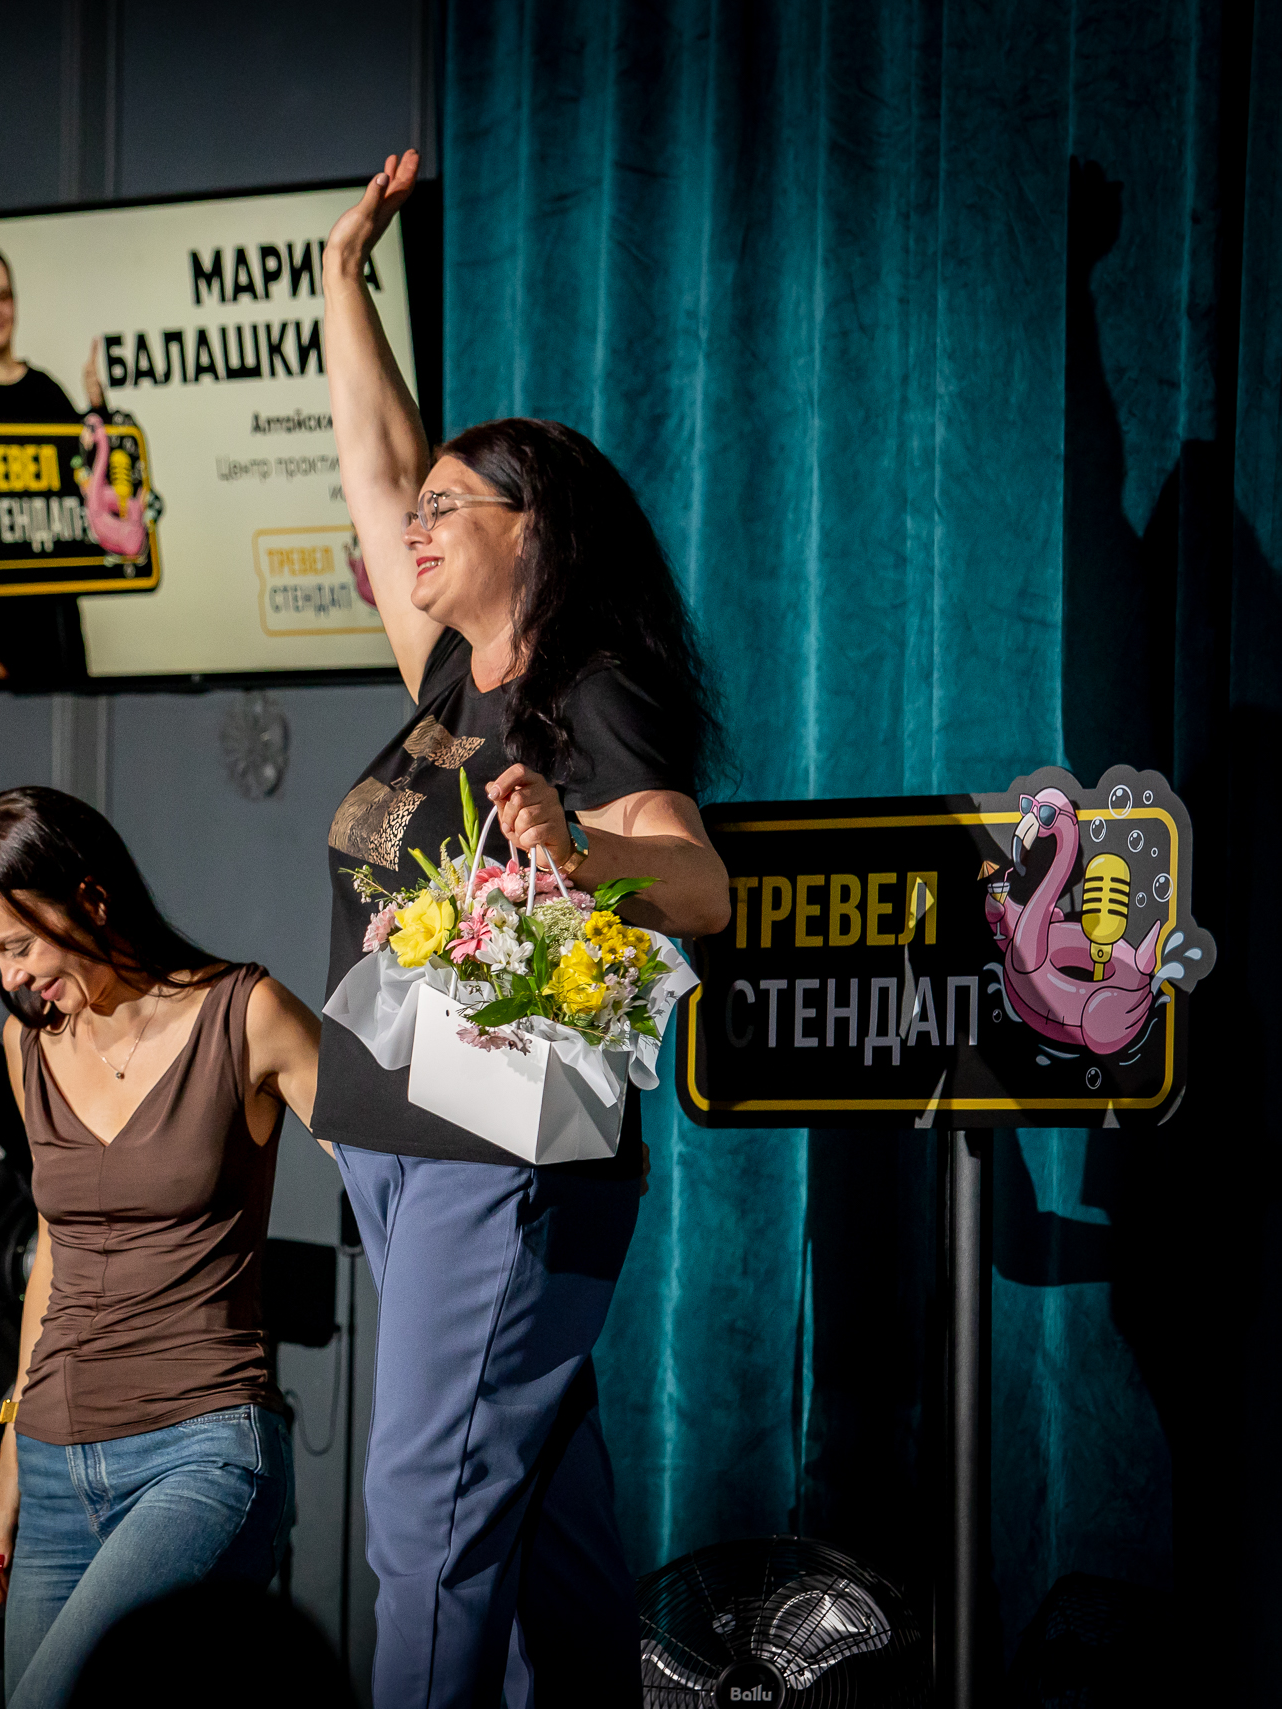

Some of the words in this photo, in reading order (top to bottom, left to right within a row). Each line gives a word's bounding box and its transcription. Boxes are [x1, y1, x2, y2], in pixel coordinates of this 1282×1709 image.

[190, 239, 382, 306] МАРИА
[104, 318, 326, 388] БАЛАШКИ
[251, 408, 333, 435] Алтайски
[215, 454, 273, 483] Центр
[274, 454, 340, 482] практи
[267, 545, 335, 577] ТРЕВЕЛ
[269, 582, 353, 618] СТЕНДАП
[729, 871, 939, 949] ТРЕВЕЛ
[725, 976, 980, 1066] СТЕНДАП
[729, 1684, 774, 1701] Ballu
